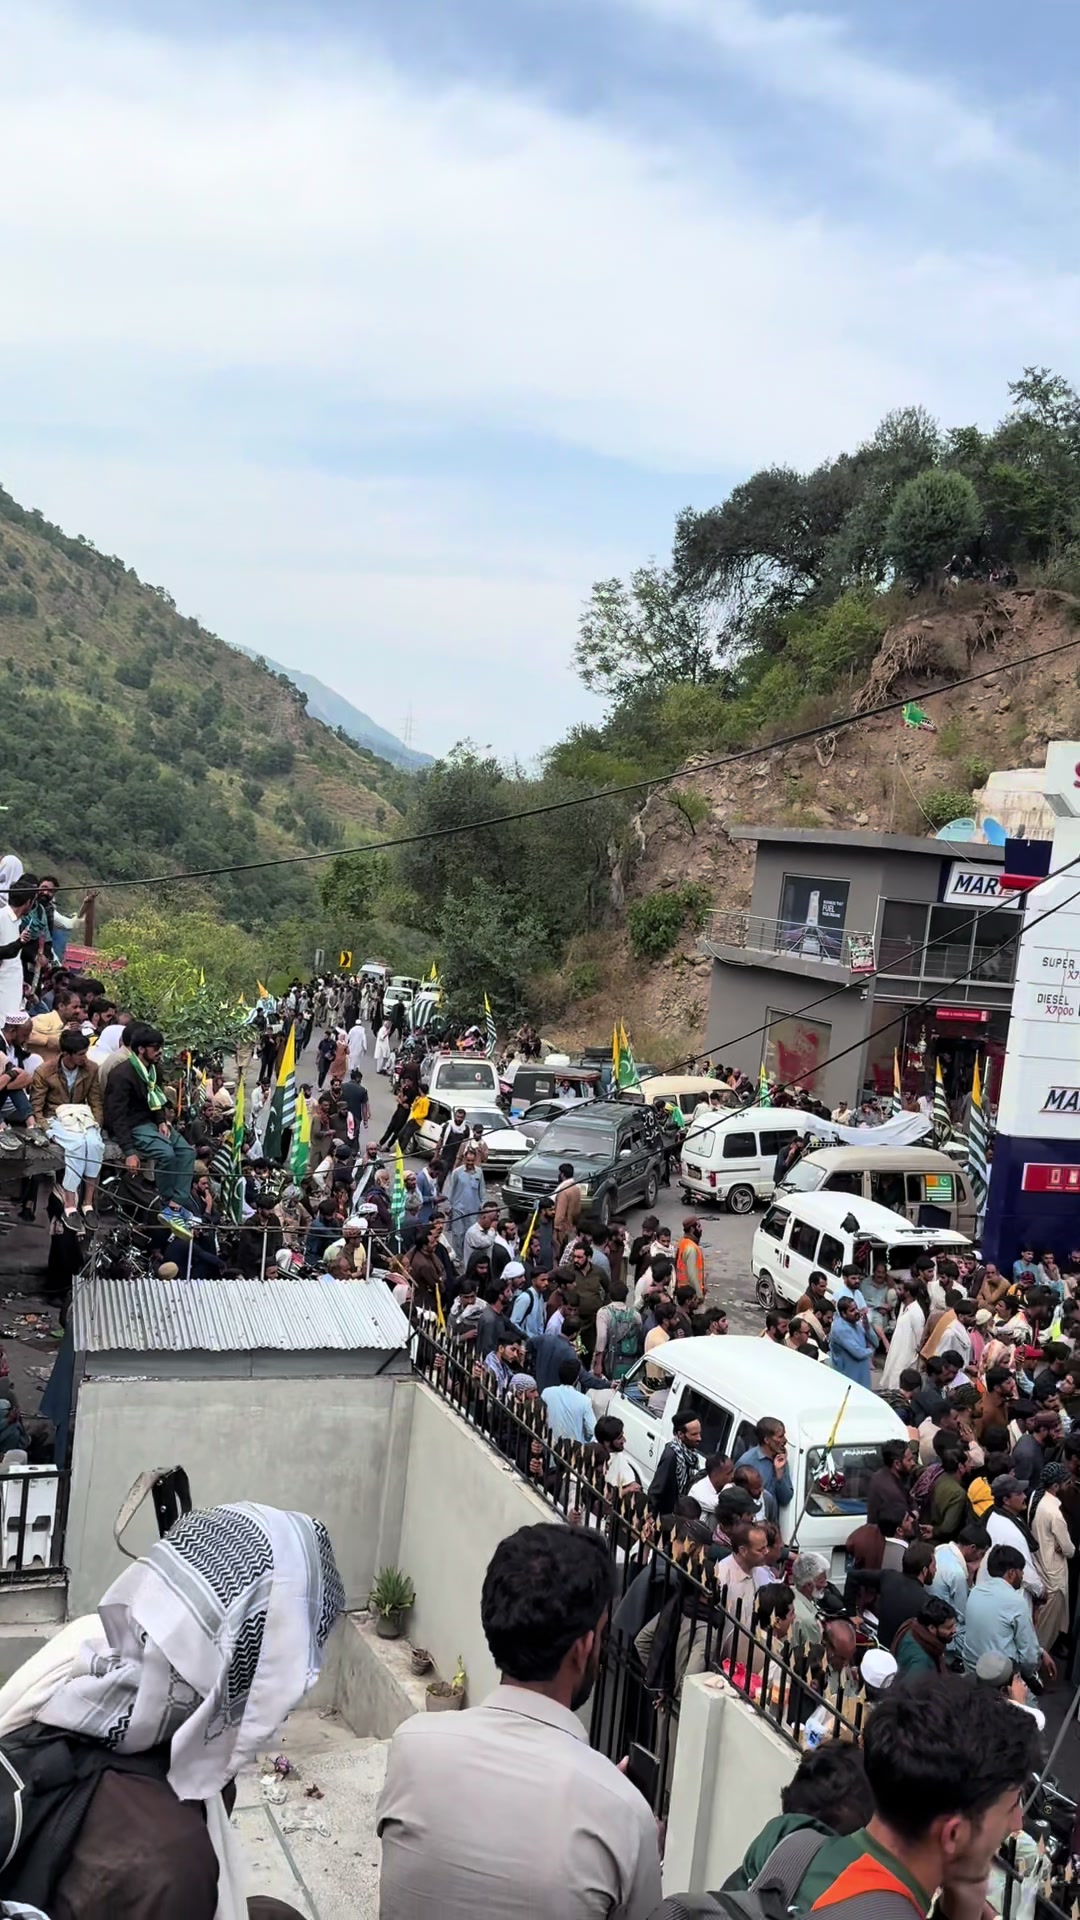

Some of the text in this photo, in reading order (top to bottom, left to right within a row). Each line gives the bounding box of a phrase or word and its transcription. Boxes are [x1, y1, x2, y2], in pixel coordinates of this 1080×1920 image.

[1042, 957, 1075, 969] SUPER
[1067, 970, 1080, 981] X7
[1037, 993, 1069, 1006] DIESEL
[1045, 1005, 1074, 1016] X7000
[1043, 1089, 1080, 1111] MA
